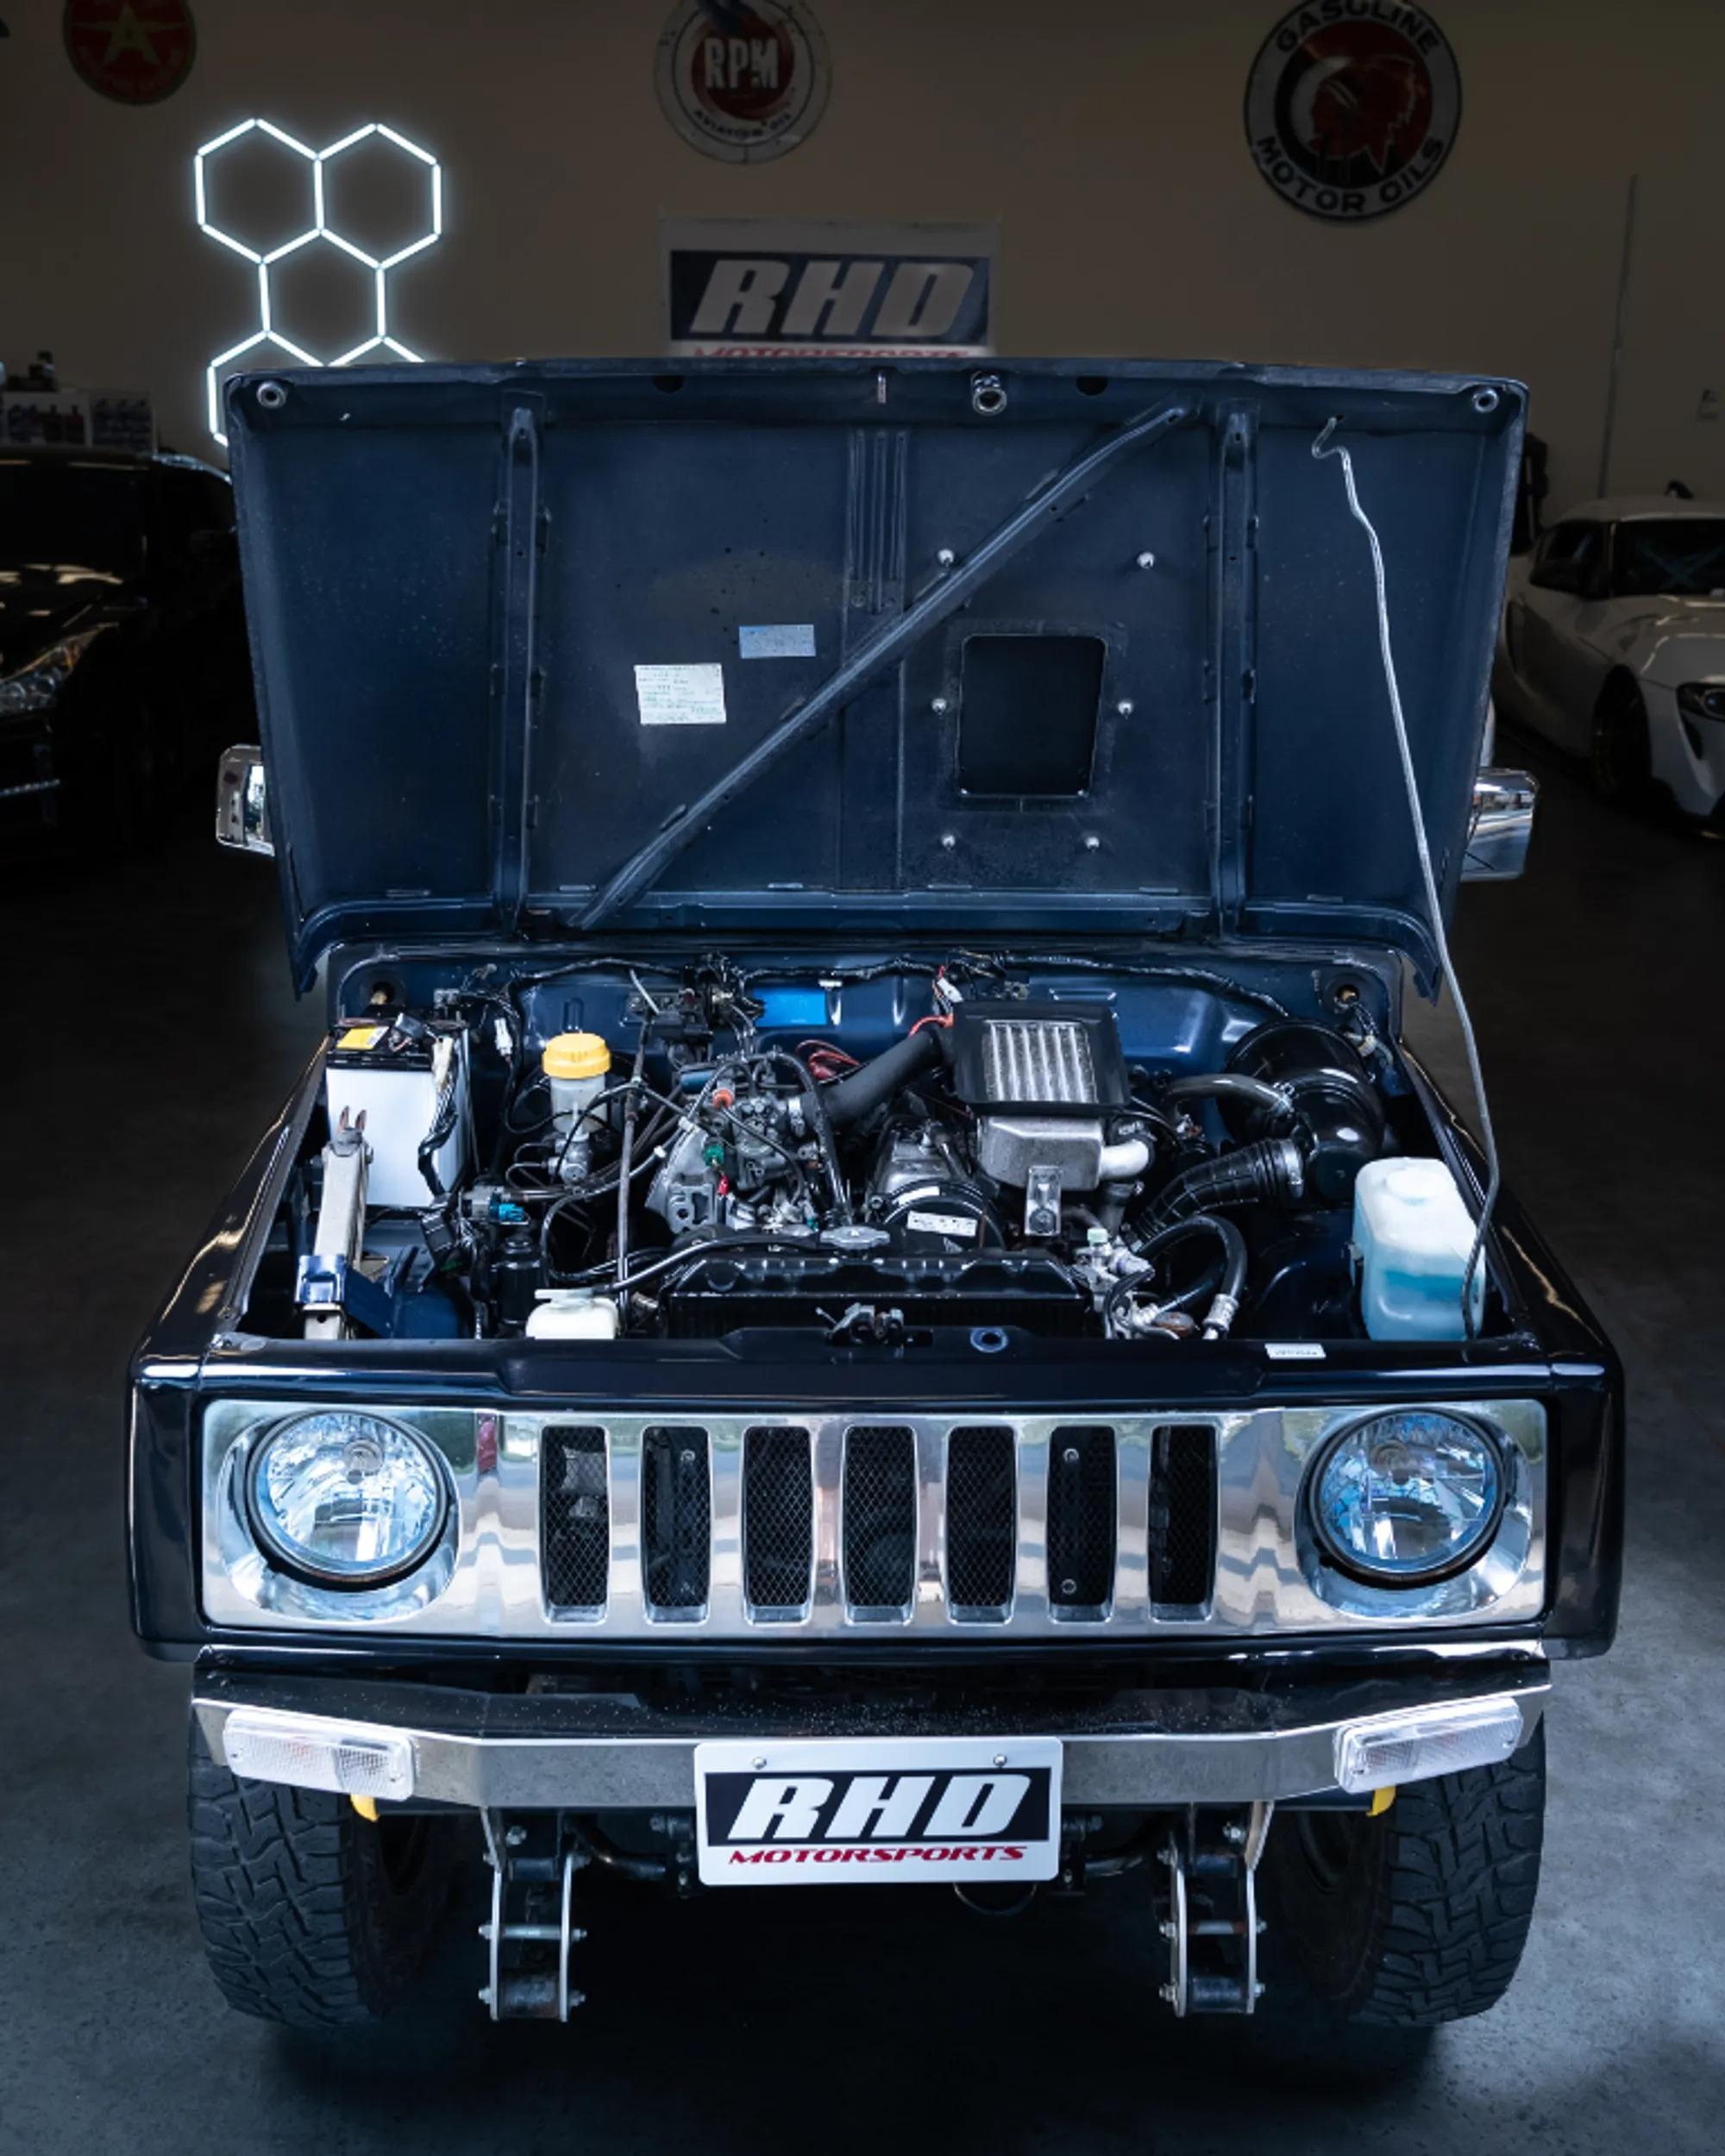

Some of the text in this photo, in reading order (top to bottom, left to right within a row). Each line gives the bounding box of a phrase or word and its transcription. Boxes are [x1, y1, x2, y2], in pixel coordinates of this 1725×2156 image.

[1276, 0, 1439, 54] GASOLINE
[704, 37, 780, 90] RPM
[1258, 135, 1444, 212] MOTOR OILS
[690, 260, 975, 336] RHD
[727, 1774, 1032, 1840] RHD
[729, 1846, 1028, 1865] MOTORSPORTS
